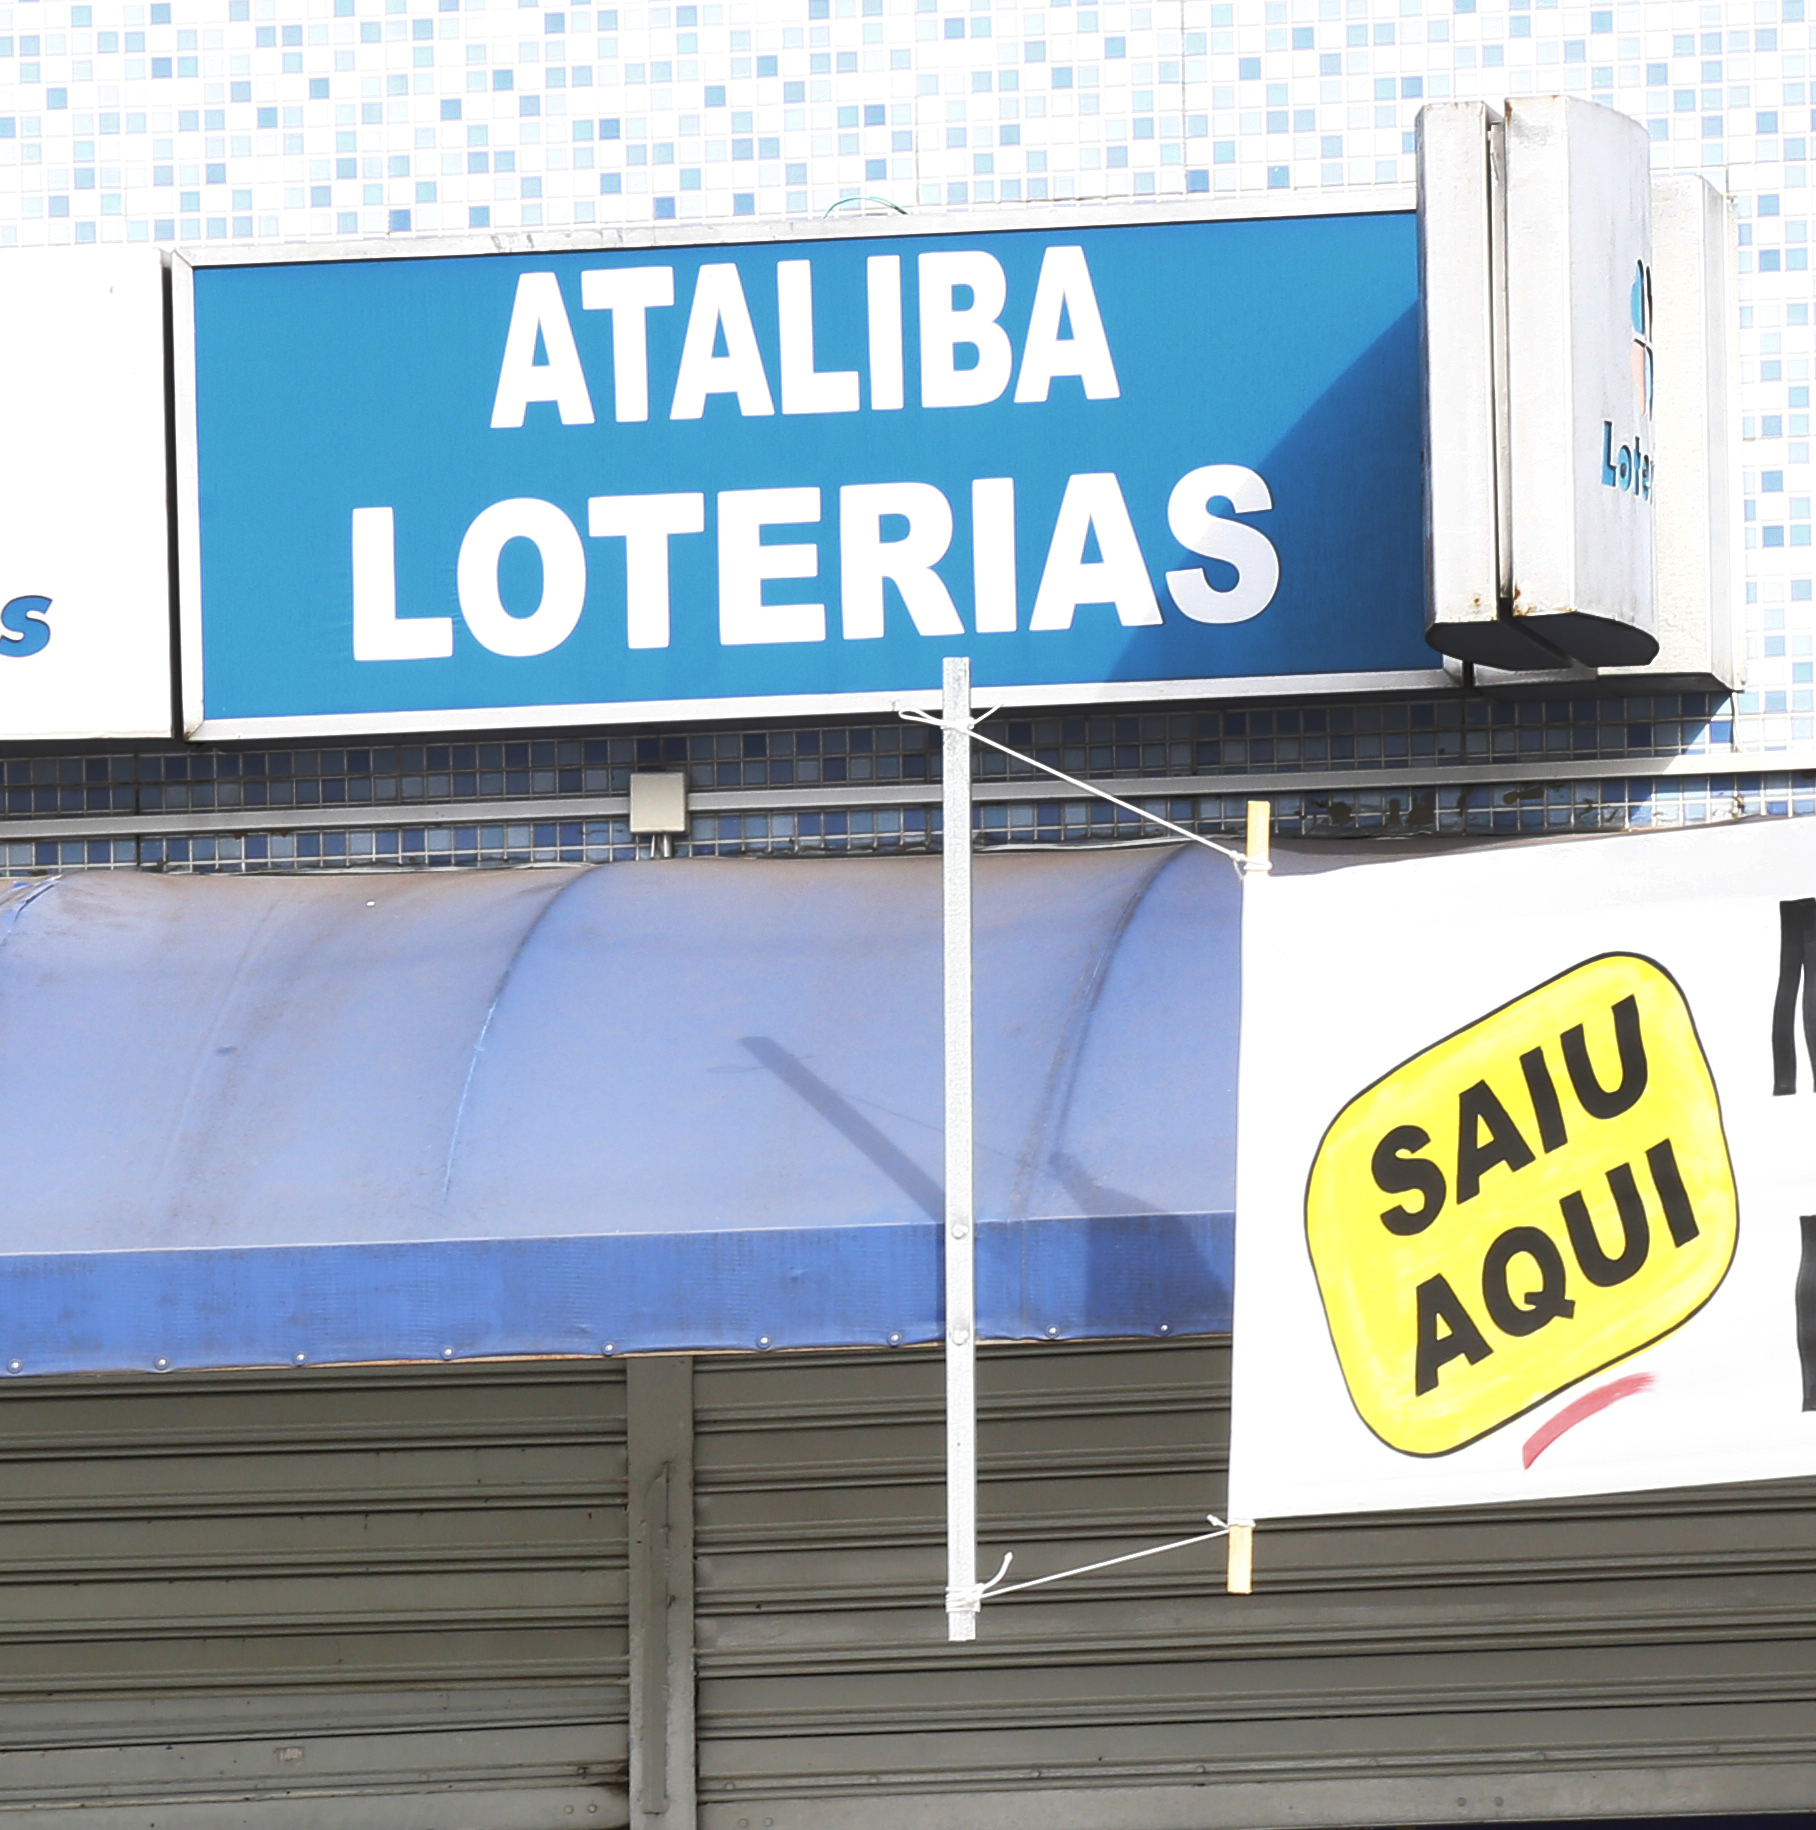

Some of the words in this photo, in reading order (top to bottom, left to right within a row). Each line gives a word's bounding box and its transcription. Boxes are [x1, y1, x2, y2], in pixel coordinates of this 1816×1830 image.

[488, 242, 1121, 430] ATALIBA
[350, 461, 1281, 664] LOTERIAS
[1600, 419, 1655, 505] Lote
[1368, 992, 1652, 1240] SAIU
[1409, 1141, 1701, 1397] AQUI
